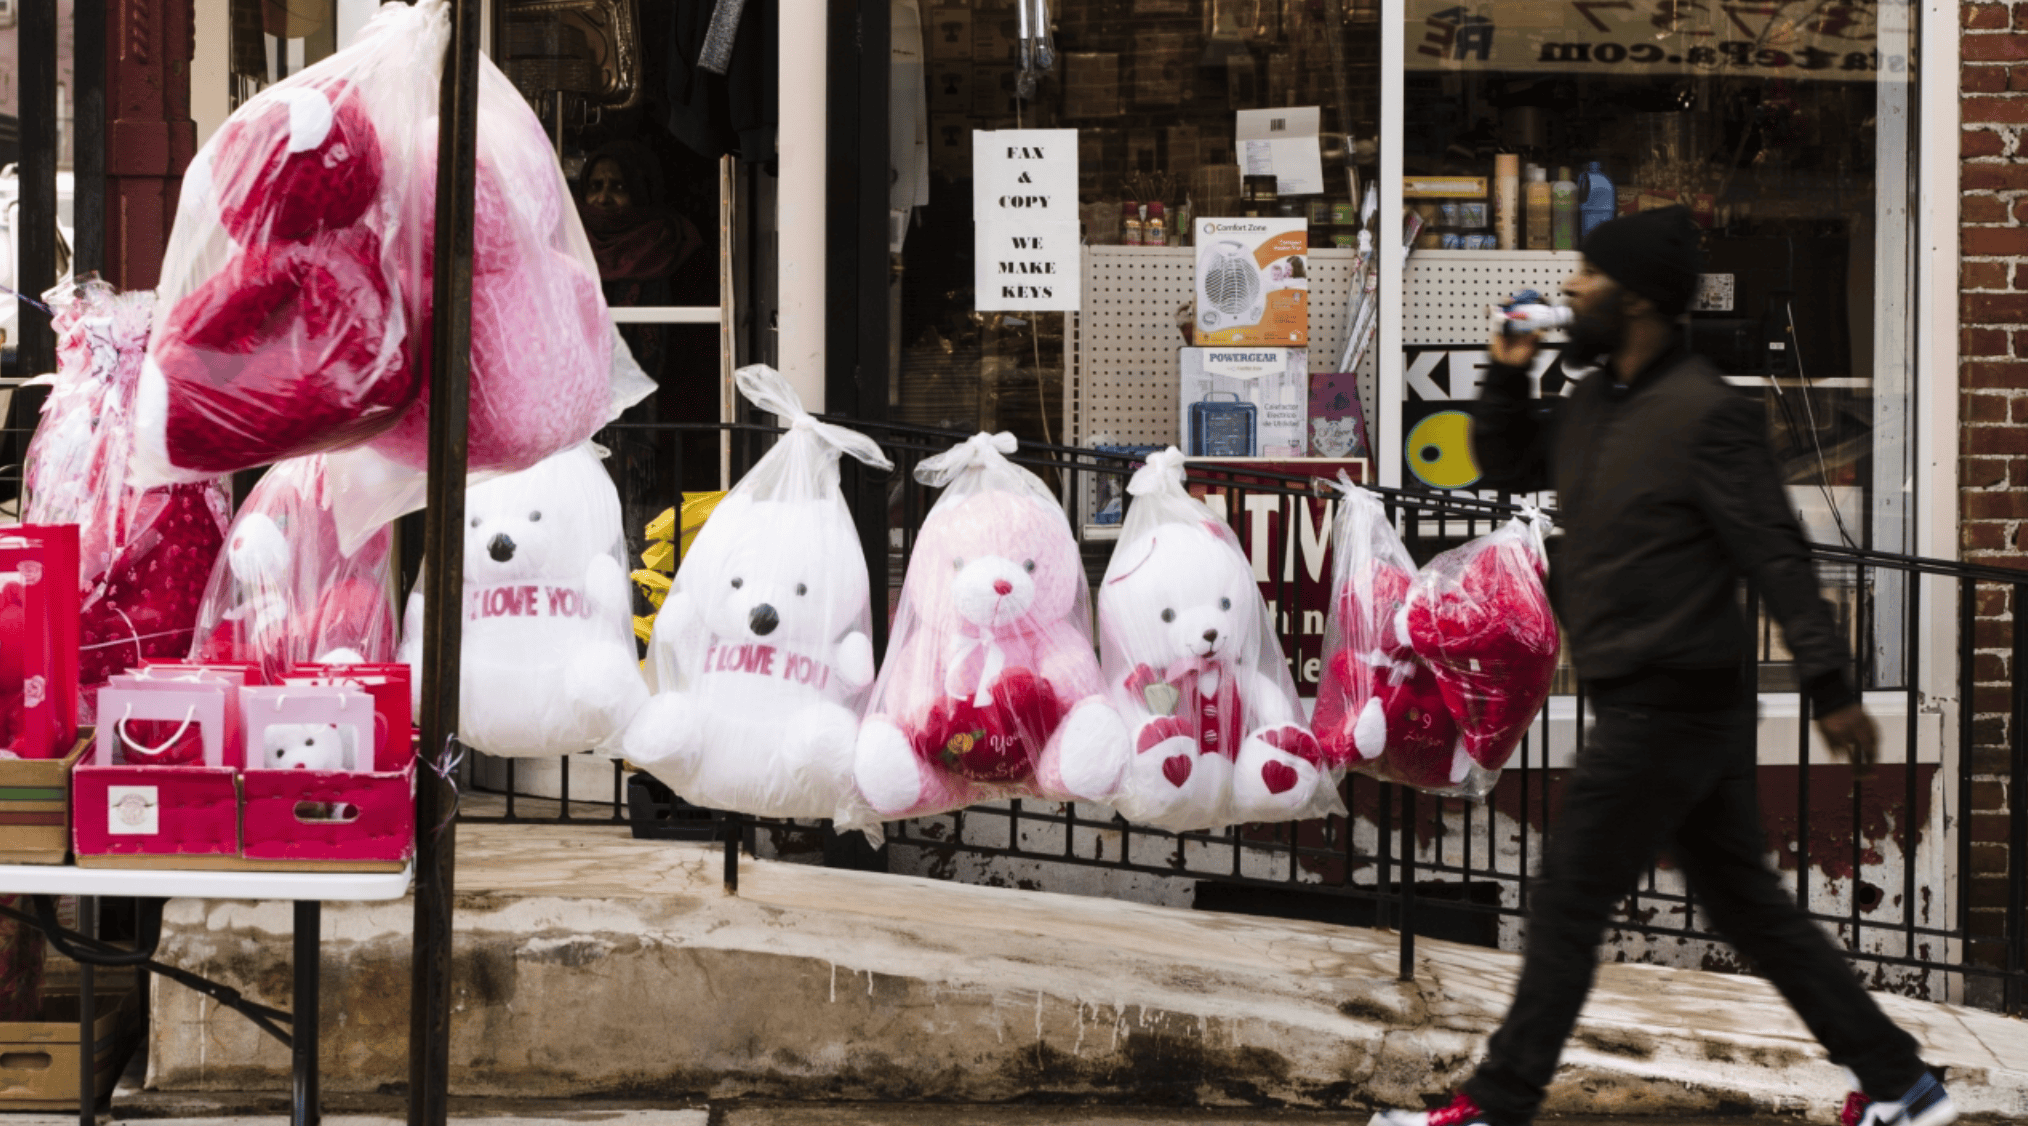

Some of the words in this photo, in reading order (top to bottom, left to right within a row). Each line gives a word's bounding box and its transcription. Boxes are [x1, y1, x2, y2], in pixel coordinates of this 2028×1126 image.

[1006, 146, 1045, 160] FAX
[1017, 171, 1032, 184] &
[998, 195, 1051, 209] COPY
[1216, 223, 1246, 232] Comfort
[1248, 223, 1267, 232] Zone
[1011, 236, 1043, 250] WE
[998, 261, 1056, 275] MAKE
[1002, 285, 1053, 299] KEYS
[1209, 353, 1278, 363] POWERGEAR
[481, 585, 539, 618] LOVE
[544, 585, 593, 621] YOU
[715, 643, 777, 676] LOVE
[783, 651, 830, 691] YOU
